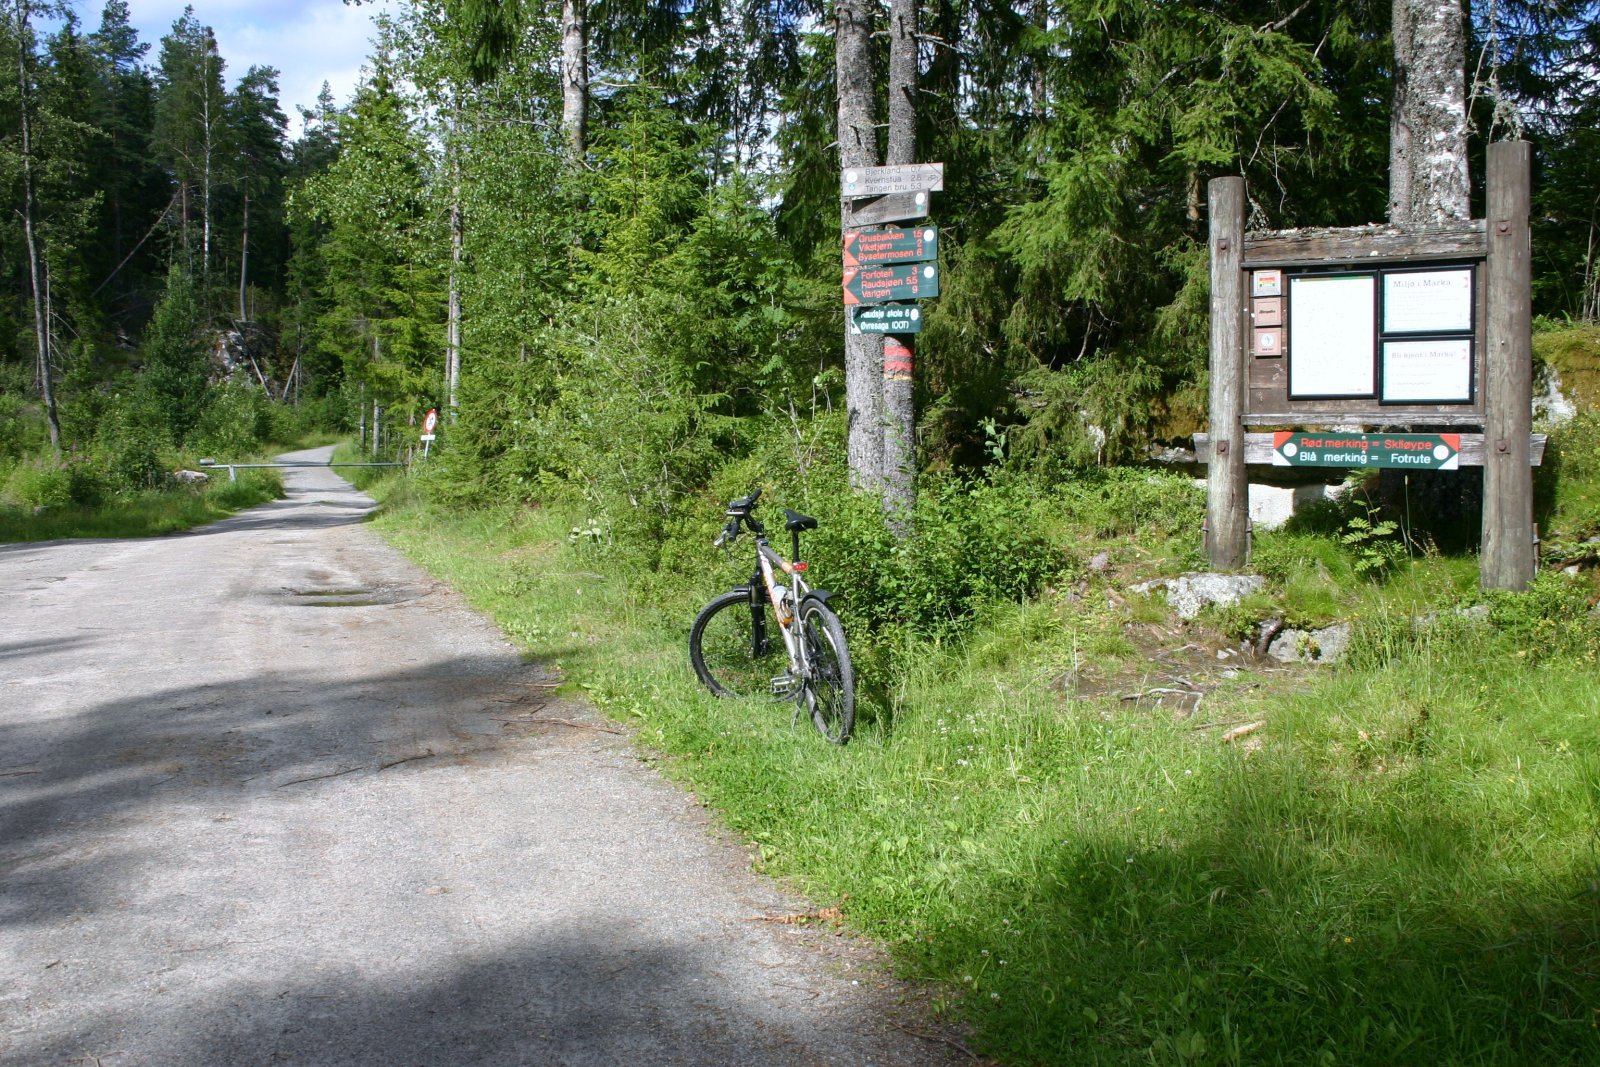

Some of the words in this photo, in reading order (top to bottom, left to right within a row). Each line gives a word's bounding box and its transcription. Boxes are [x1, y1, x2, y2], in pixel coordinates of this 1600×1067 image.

[865, 185, 892, 193] Tangen
[916, 238, 923, 247] 2
[911, 266, 918, 275] 3
[1423, 279, 1451, 287] Marka
[861, 289, 891, 299] Vangen
[911, 285, 918, 294] 9
[886, 309, 903, 318] skole
[1299, 438, 1323, 448] Rød
[1325, 438, 1369, 451] merking
[1384, 438, 1433, 451] Skiløype
[1299, 451, 1317, 462] Blå
[1323, 452, 1368, 464] merking
[1390, 453, 1432, 464] Fotrute
